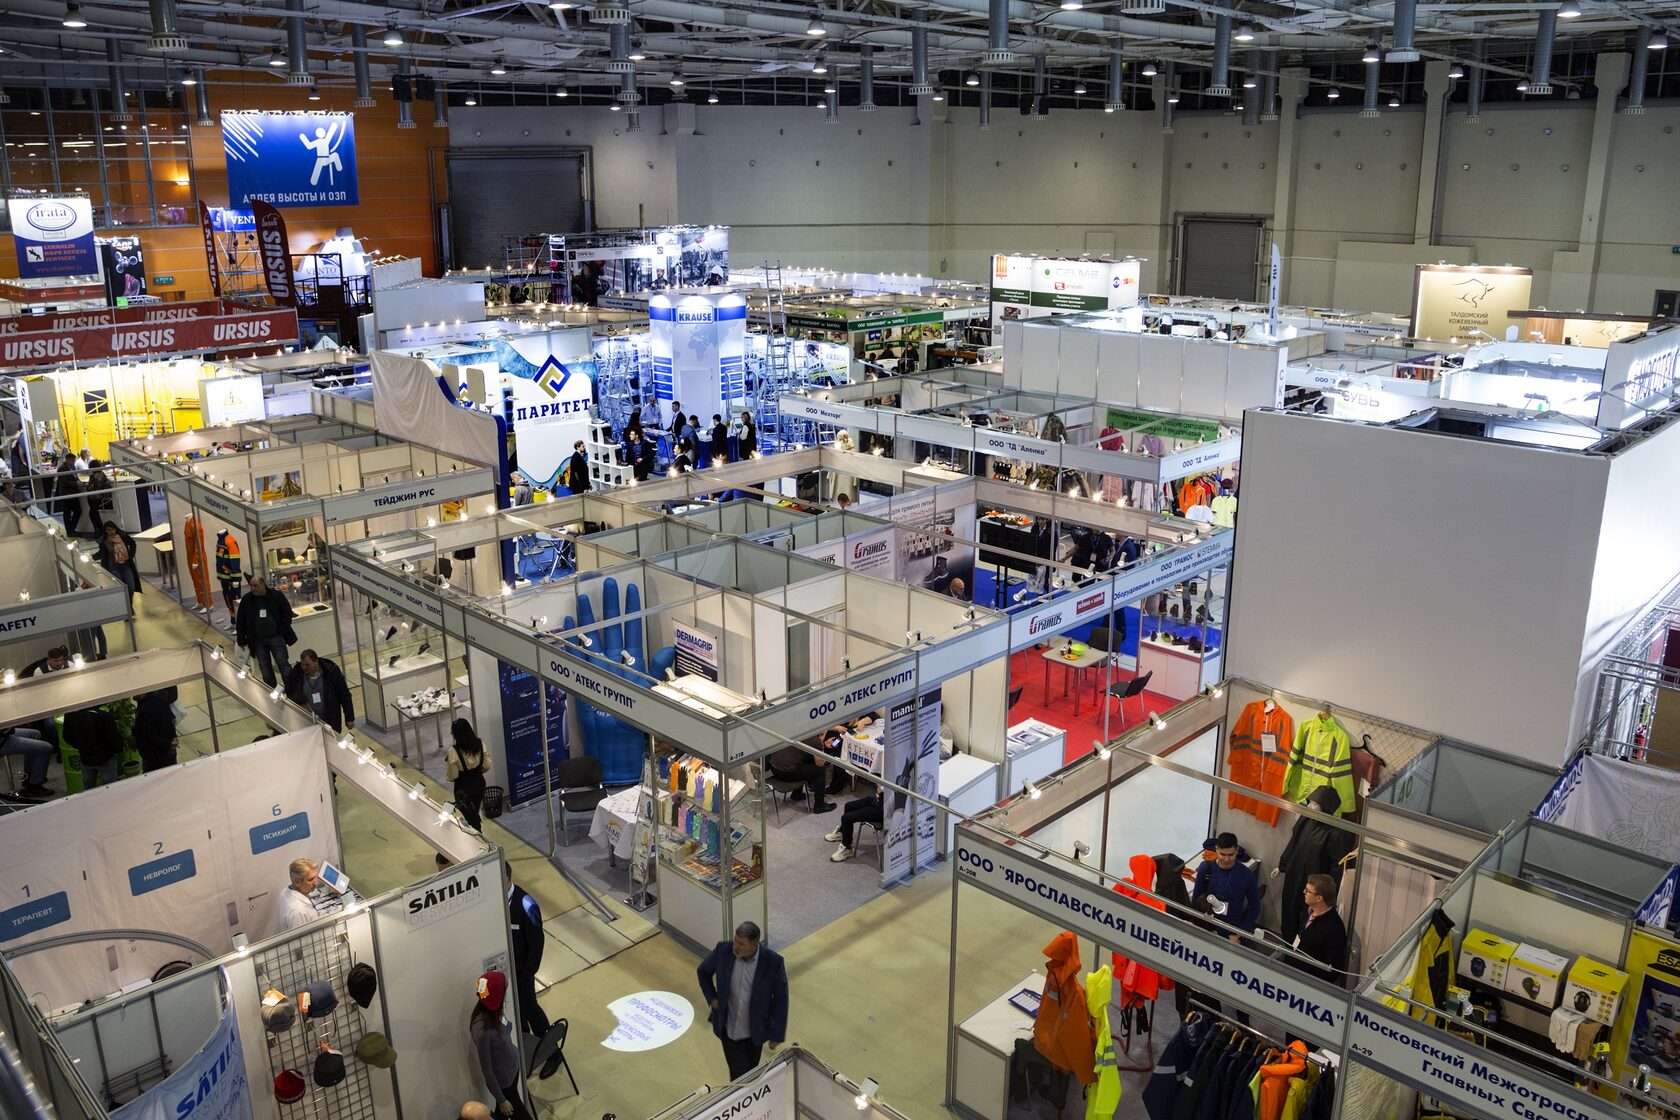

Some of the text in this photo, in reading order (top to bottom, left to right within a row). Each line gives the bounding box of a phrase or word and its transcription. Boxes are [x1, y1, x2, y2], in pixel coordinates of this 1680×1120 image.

[278, 192, 317, 203] ВЫСОТЫ
[319, 192, 326, 201] И
[328, 191, 347, 201] ОЗП
[230, 215, 256, 226] VENT
[261, 230, 290, 298] URSUS
[53, 315, 111, 333] URSUS
[144, 308, 199, 325] URSUS
[678, 312, 713, 323] KRAUSE
[1448, 318, 1489, 326] КОЖЕВЕННЫЙ
[1450, 311, 1489, 319] ТАЛДОМСКИЙ
[111, 328, 176, 351] URSUS
[213, 319, 272, 342] URSUS
[4, 337, 75, 361] URSUS
[516, 398, 591, 421] ПАРИТЕТ
[805, 407, 818, 415] ООО
[988, 439, 1005, 448] ООО
[1019, 443, 1048, 457] "Аленка"
[1182, 459, 1194, 468] ООО
[373, 488, 435, 507] ТЕЙДЖИН РУС
[1160, 562, 1173, 572] ООО
[1113, 581, 1151, 601] Оборудование
[1182, 563, 1192, 573] для
[0, 615, 38, 635] AFETY
[676, 629, 713, 652] DERMAGRIP
[550, 660, 637, 709] ООО "АТЕКС ГРУПП"
[808, 667, 916, 720] ООО "АТЕКС ГРУПП"
[892, 697, 926, 720] manul
[918, 708, 937, 719] ЕРЧАТКИ
[271, 803, 283, 817] 6
[262, 824, 298, 841] ПСИХИАТР
[153, 841, 165, 856] 2
[143, 863, 183, 882] НЕВРОЛОГ
[21, 884, 32, 898] 1
[408, 874, 480, 915] SÄTILA
[11, 906, 54, 927] ТЕРАПЕВТ
[409, 888, 481, 926] OF SWEDEN
[958, 847, 1346, 1029] ООО "ЯРОСЛАВСКАЯ ШВЕЙНАЯ ФАБРИКА"
[1656, 952, 1680, 969] ESA
[1351, 1043, 1373, 1057] A-29
[1353, 1011, 1465, 1070] Московский
[1470, 1061, 1596, 1120] Межотрасл
[1420, 1059, 1550, 1120] Главных Сва
